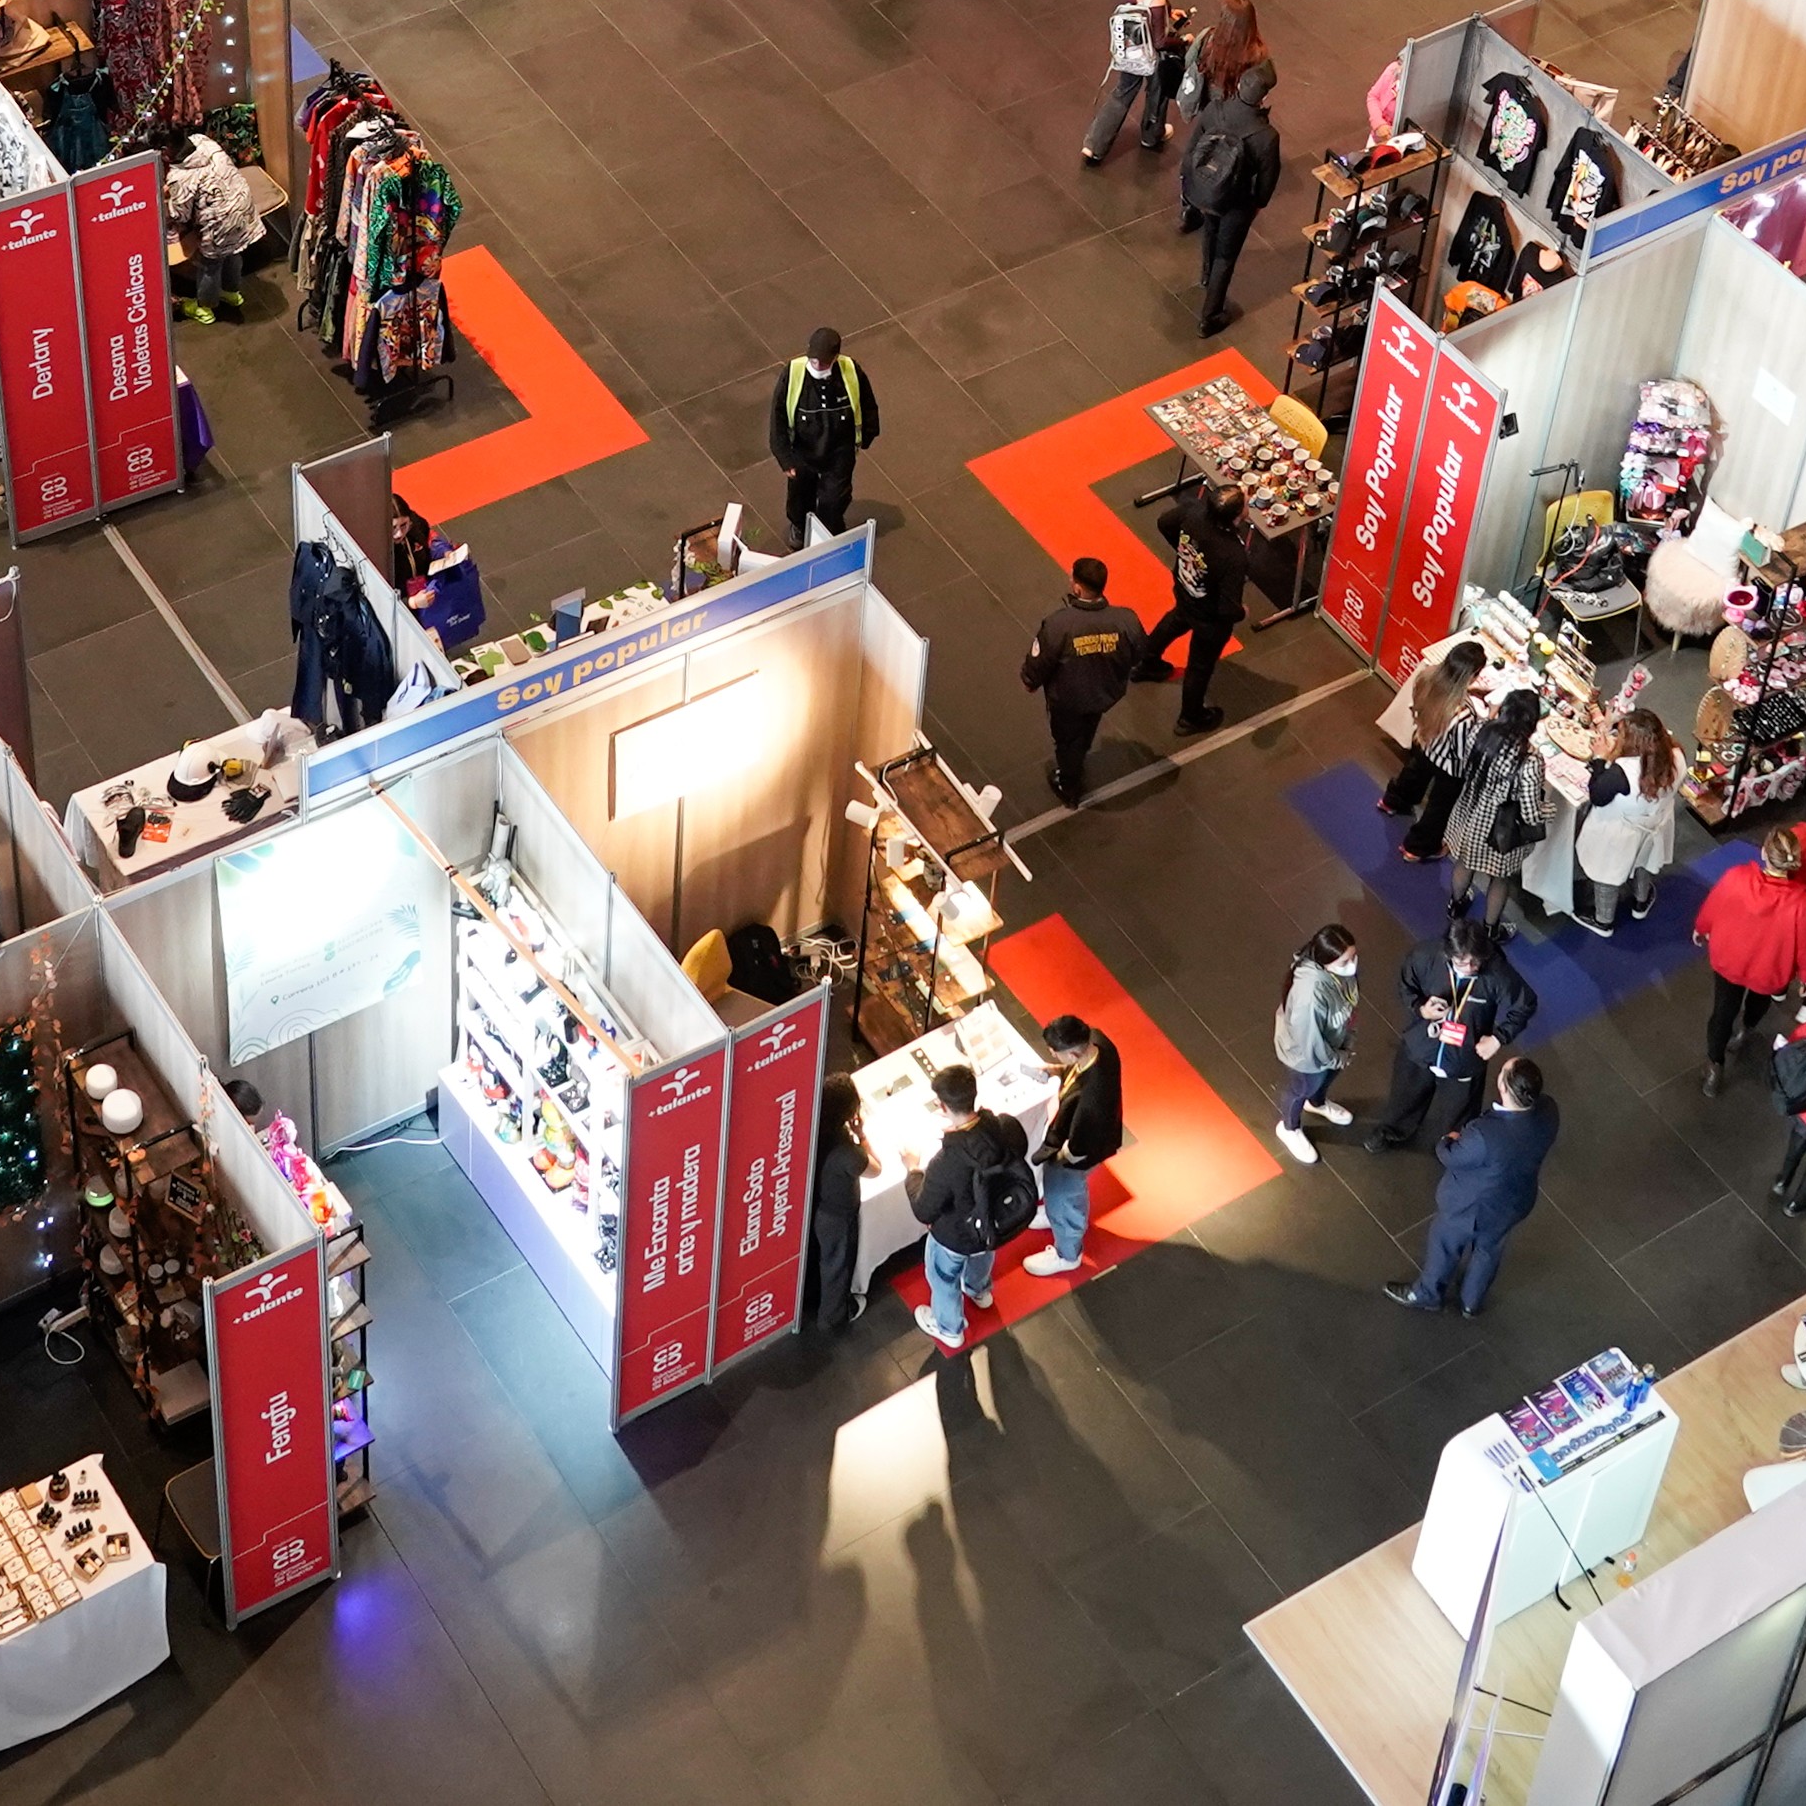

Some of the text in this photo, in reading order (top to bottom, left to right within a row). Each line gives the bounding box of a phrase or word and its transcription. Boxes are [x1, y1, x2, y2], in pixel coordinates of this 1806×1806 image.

[1720, 165, 1764, 194] Soy
[32, 327, 54, 400] Derlary
[108, 334, 128, 401] Desana
[132, 324, 152, 395] Violetas
[1355, 384, 1404, 552] Soy Popular
[1412, 440, 1465, 609] Soy Popular
[496, 609, 710, 712] Soy popular
[771, 1089, 796, 1180] Artesanal
[675, 1144, 700, 1216] madera
[740, 1157, 764, 1257] Eliana Soto
[643, 1176, 670, 1294] Me Encanta
[676, 1232, 695, 1276] arte
[265, 1391, 297, 1465] Fengfu
